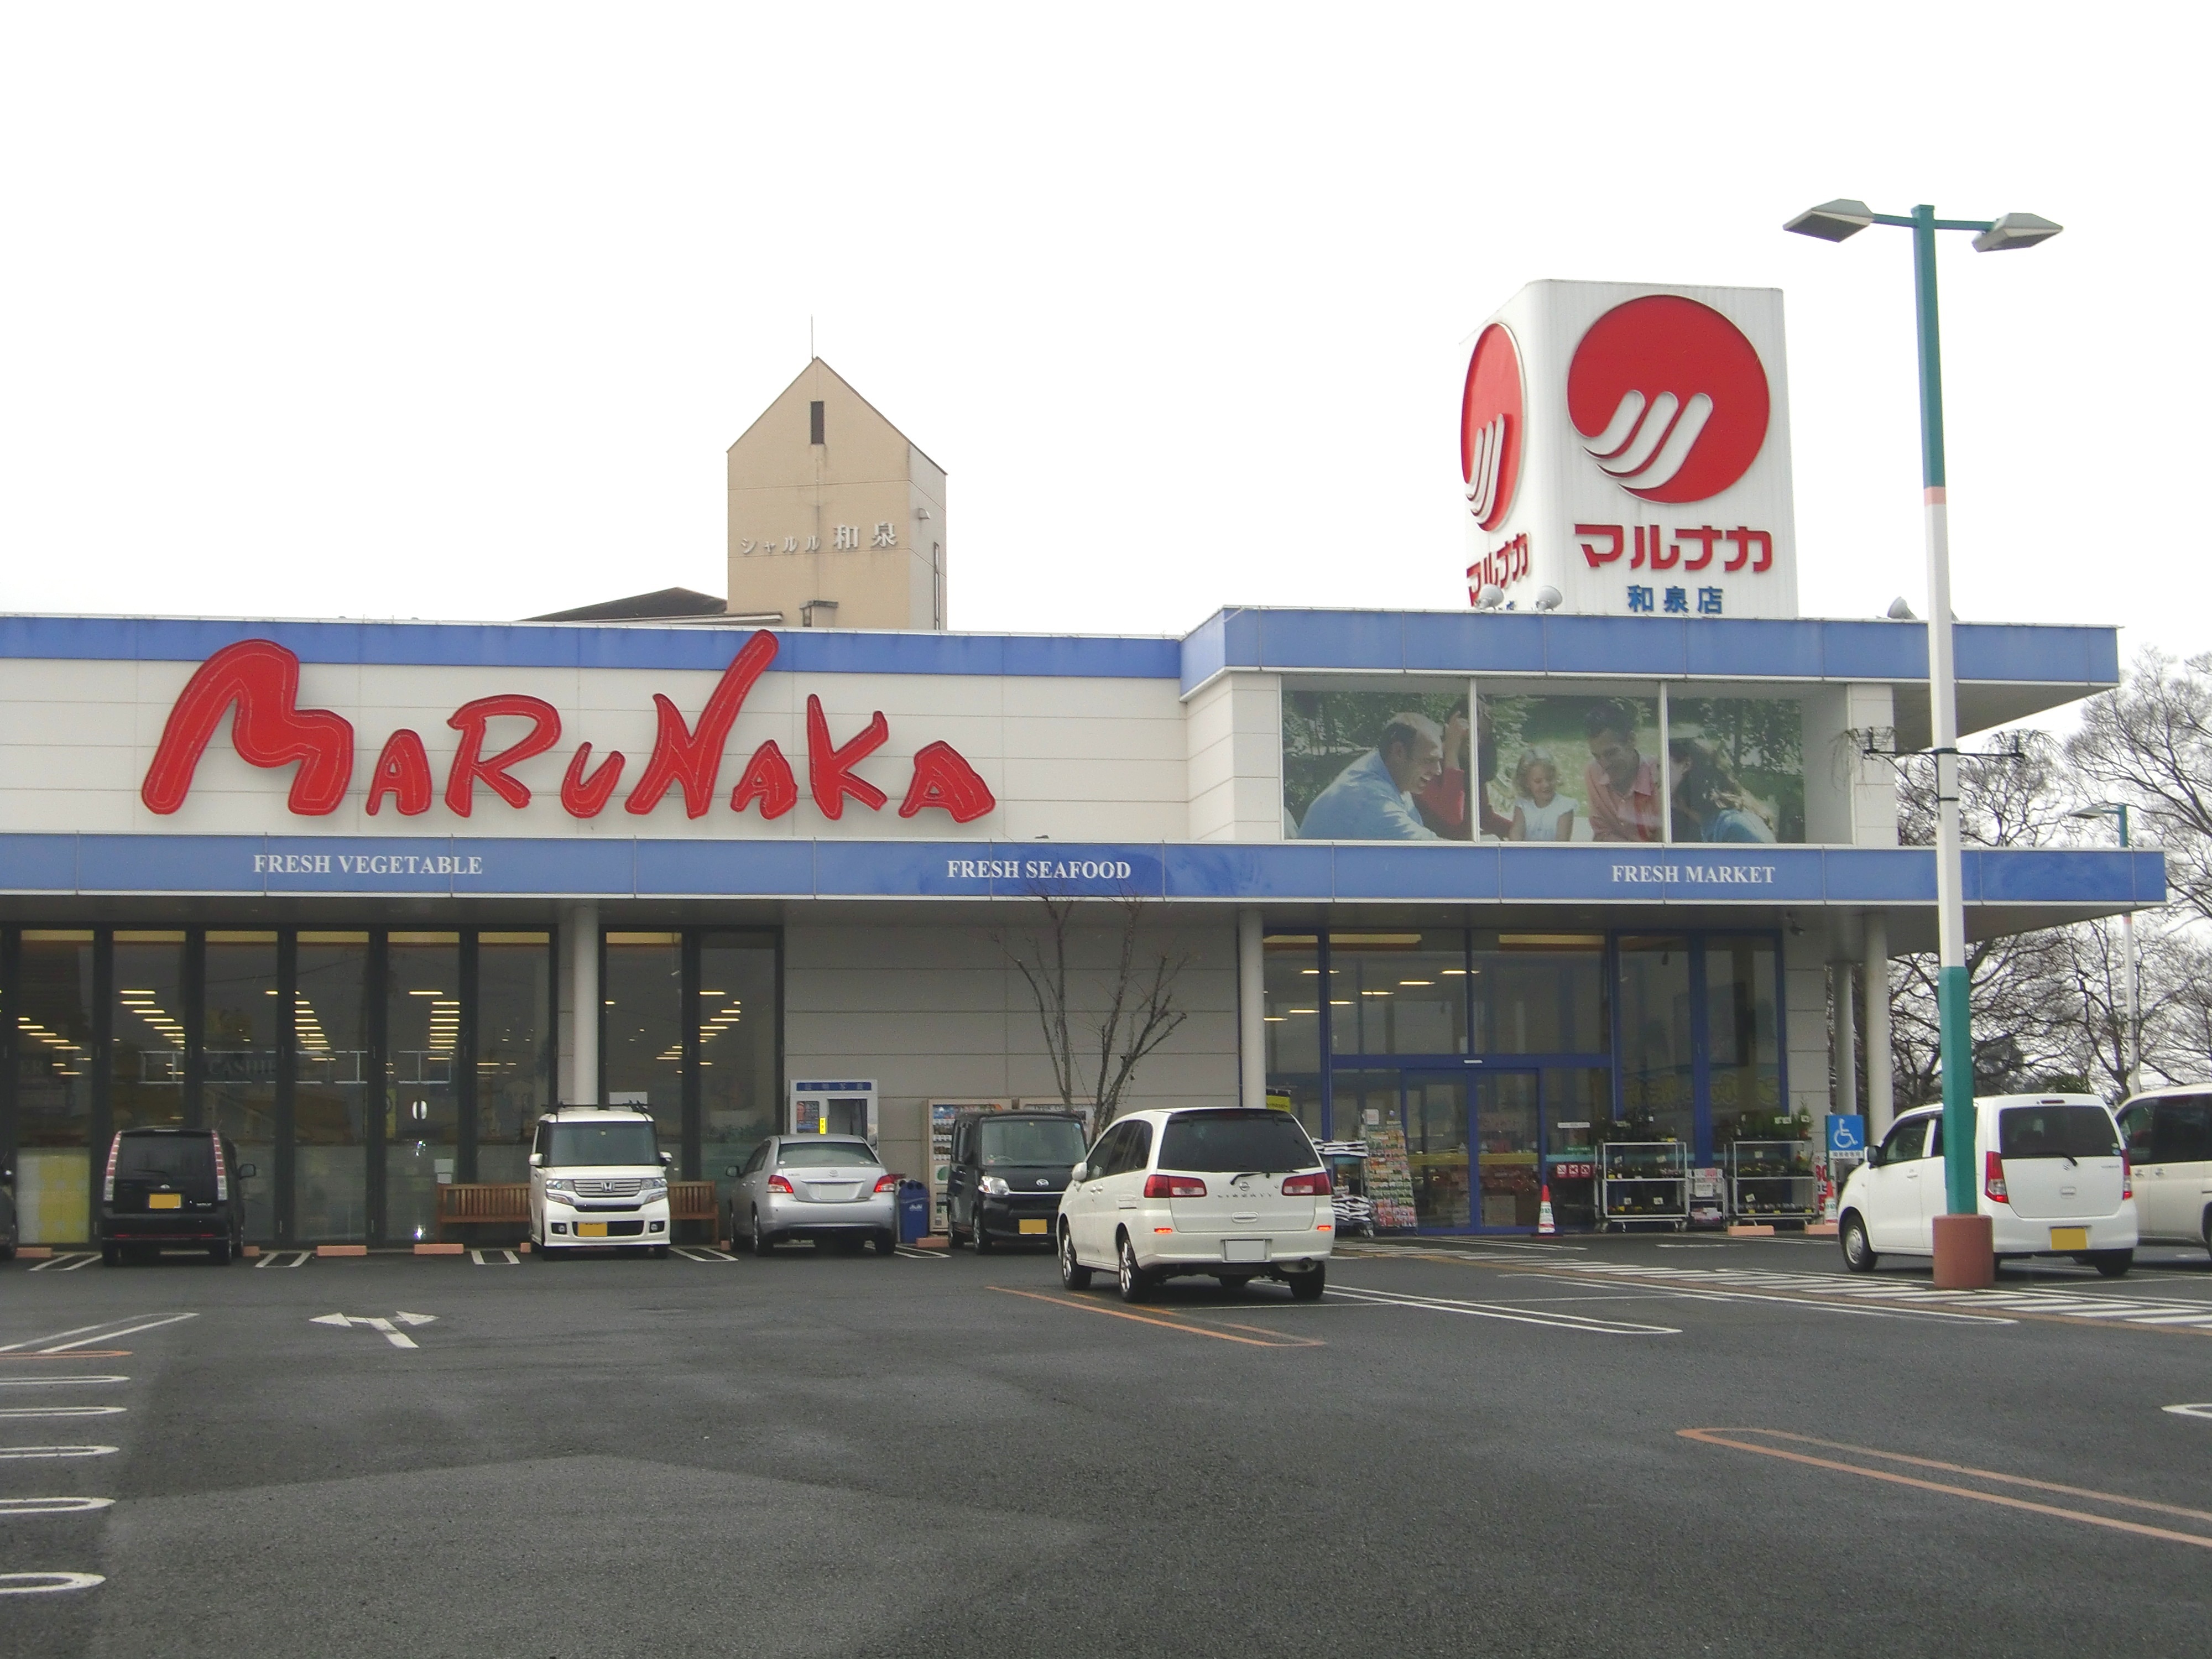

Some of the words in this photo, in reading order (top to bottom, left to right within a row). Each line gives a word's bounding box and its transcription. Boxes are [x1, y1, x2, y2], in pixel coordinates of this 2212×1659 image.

[740, 522, 898, 554] シャルル和泉
[1574, 524, 1773, 572] マルナカ
[1466, 533, 1529, 607] マルナカ
[1627, 585, 1723, 614] 和泉店
[254, 854, 331, 873] FRESH
[338, 855, 483, 874] VEGETABLE
[947, 860, 1020, 878] FRESH
[1025, 860, 1131, 879] SEAFOOD
[1611, 865, 1680, 883] FRESH
[1685, 865, 1776, 884] MARKET
